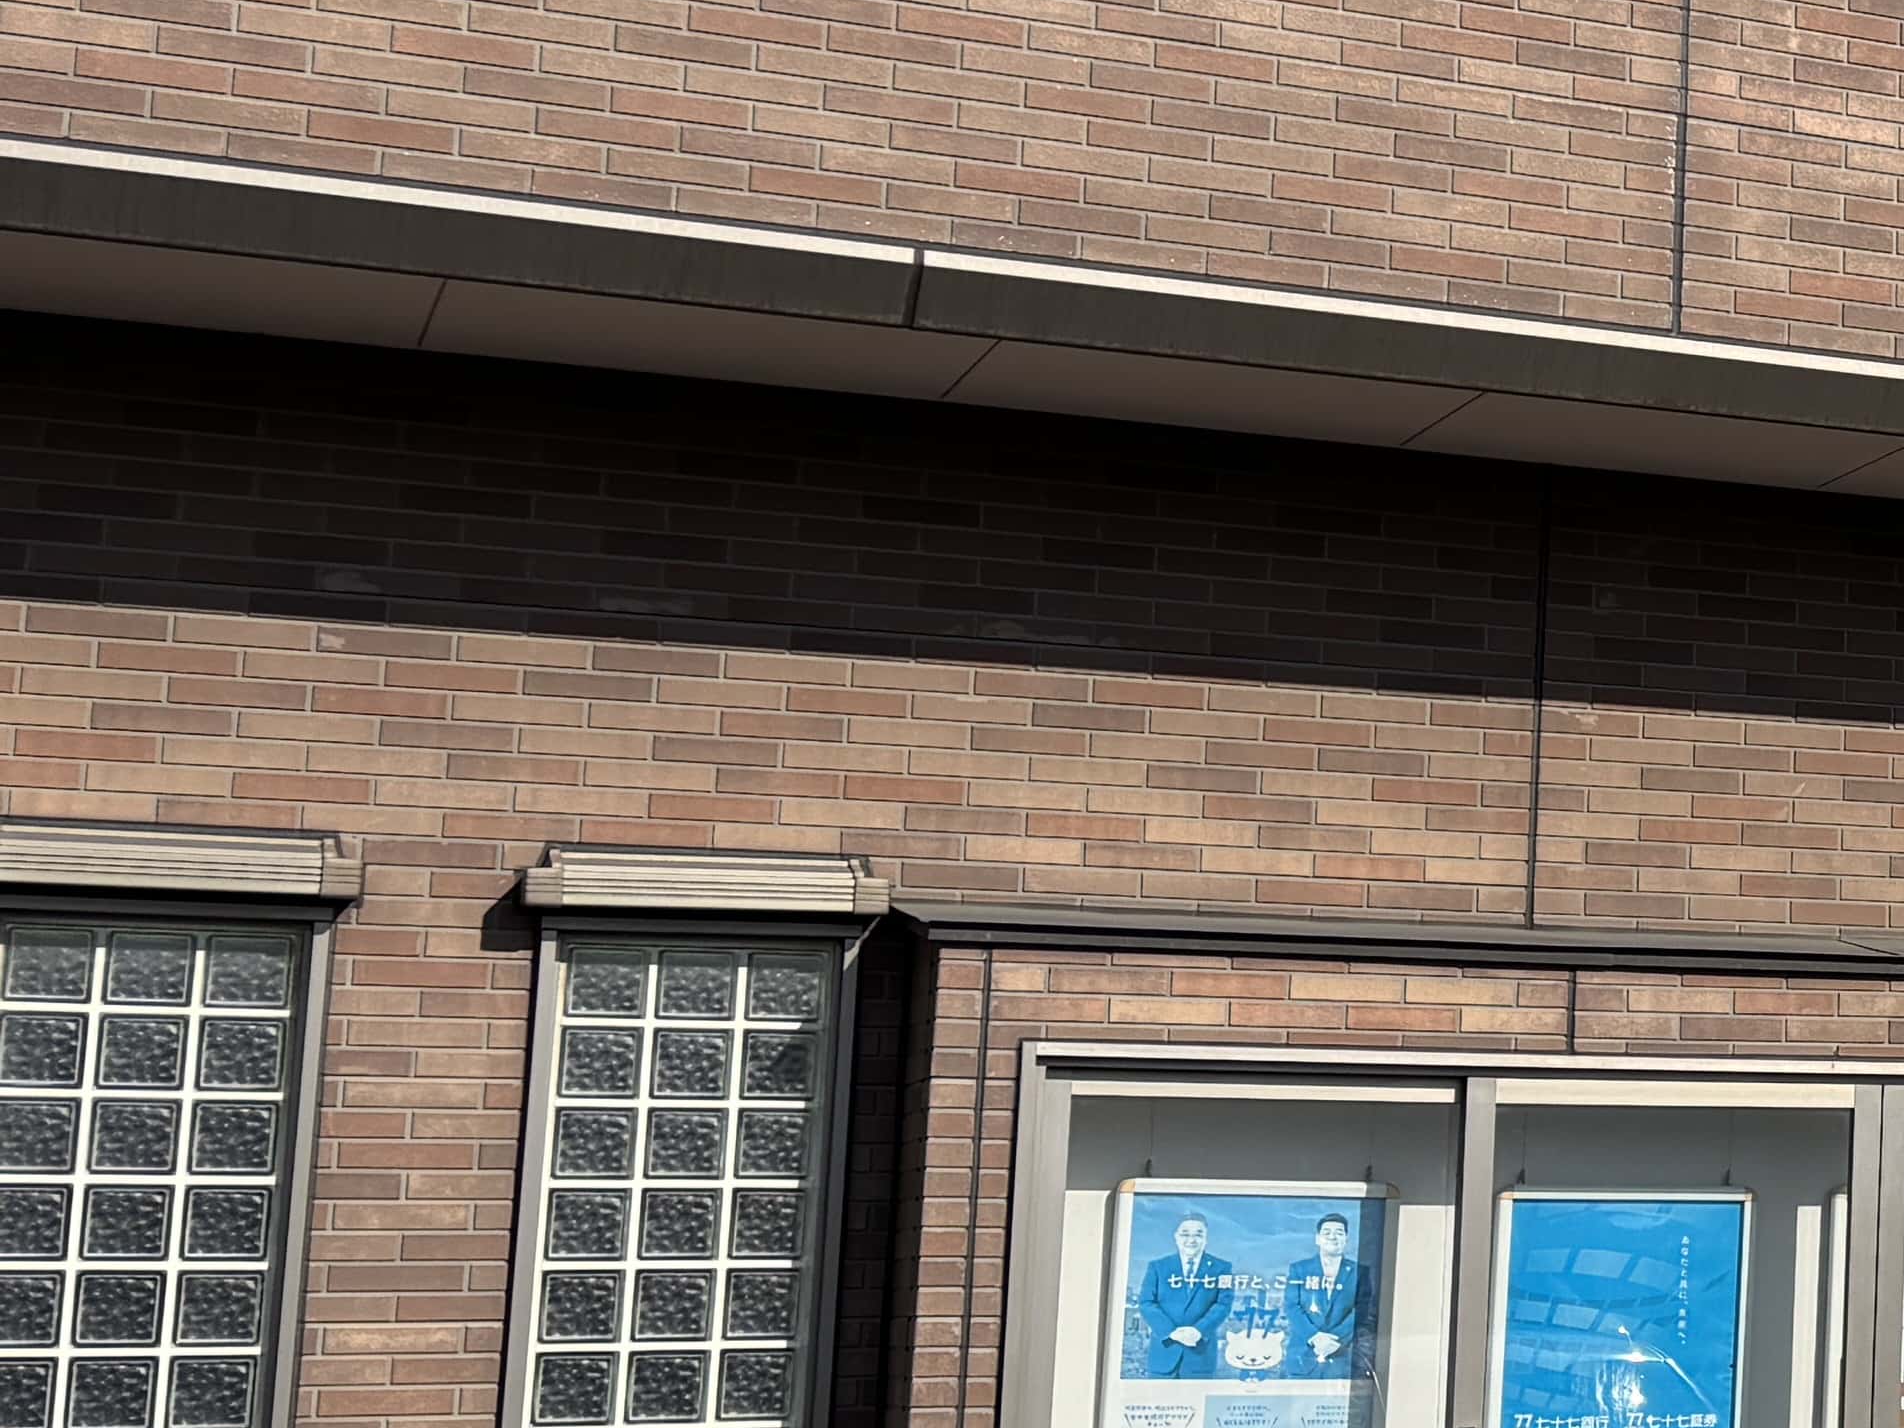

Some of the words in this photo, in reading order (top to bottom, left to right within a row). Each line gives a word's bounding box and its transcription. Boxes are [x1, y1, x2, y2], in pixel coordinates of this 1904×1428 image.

[1168, 1273, 1343, 1290] 七十七銀行と、ご一緒に。
